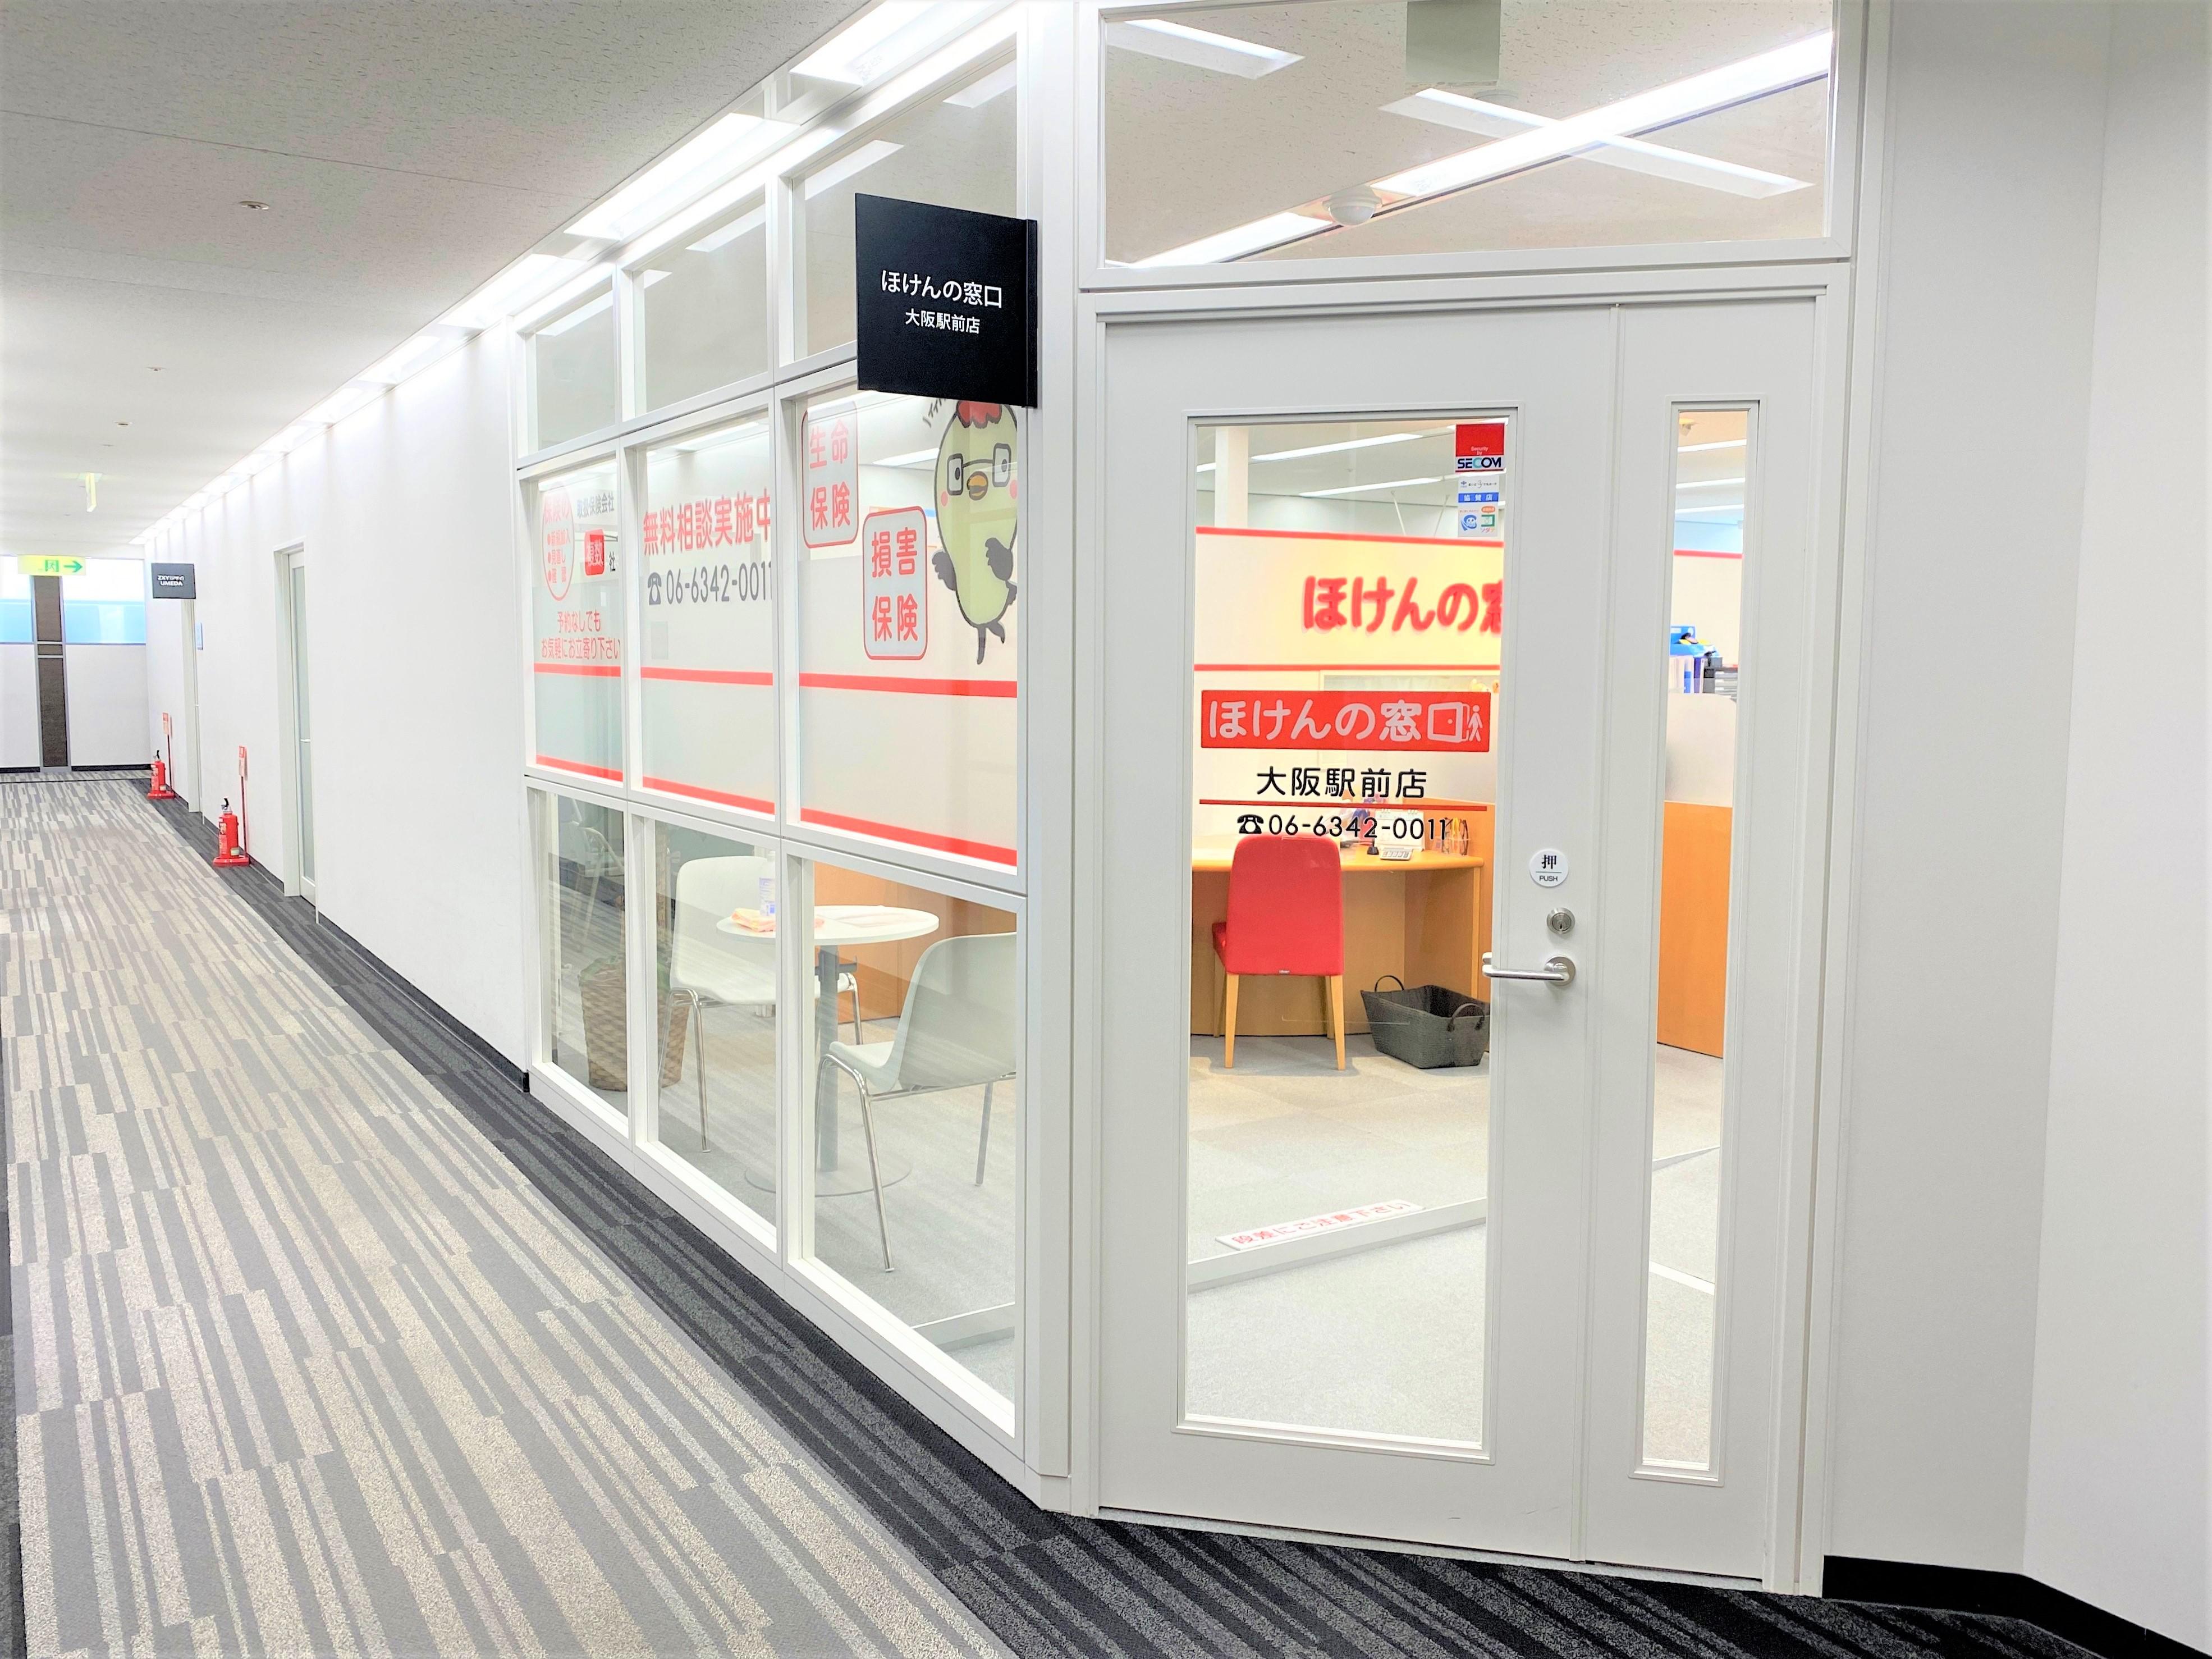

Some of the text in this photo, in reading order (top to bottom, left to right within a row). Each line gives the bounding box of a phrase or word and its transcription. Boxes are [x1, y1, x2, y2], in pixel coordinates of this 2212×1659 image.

[881, 269, 1002, 308] ほけんの窓口
[905, 308, 981, 334] 大阪駅前店
[809, 418, 849, 469] 生命
[1458, 457, 1501, 468] SECOM
[643, 487, 771, 557] 無料相談実施中
[810, 481, 851, 531] 保険
[871, 527, 918, 578] 損害
[557, 609, 601, 633] 予約なしでも
[872, 593, 918, 642] 保険
[542, 637, 621, 660] お気軽にお立寄り下さい
[1256, 766, 1427, 798] 大阪駅前店
[1268, 814, 1446, 841] 06-6342-0011
[1541, 854, 1557, 870] 押
